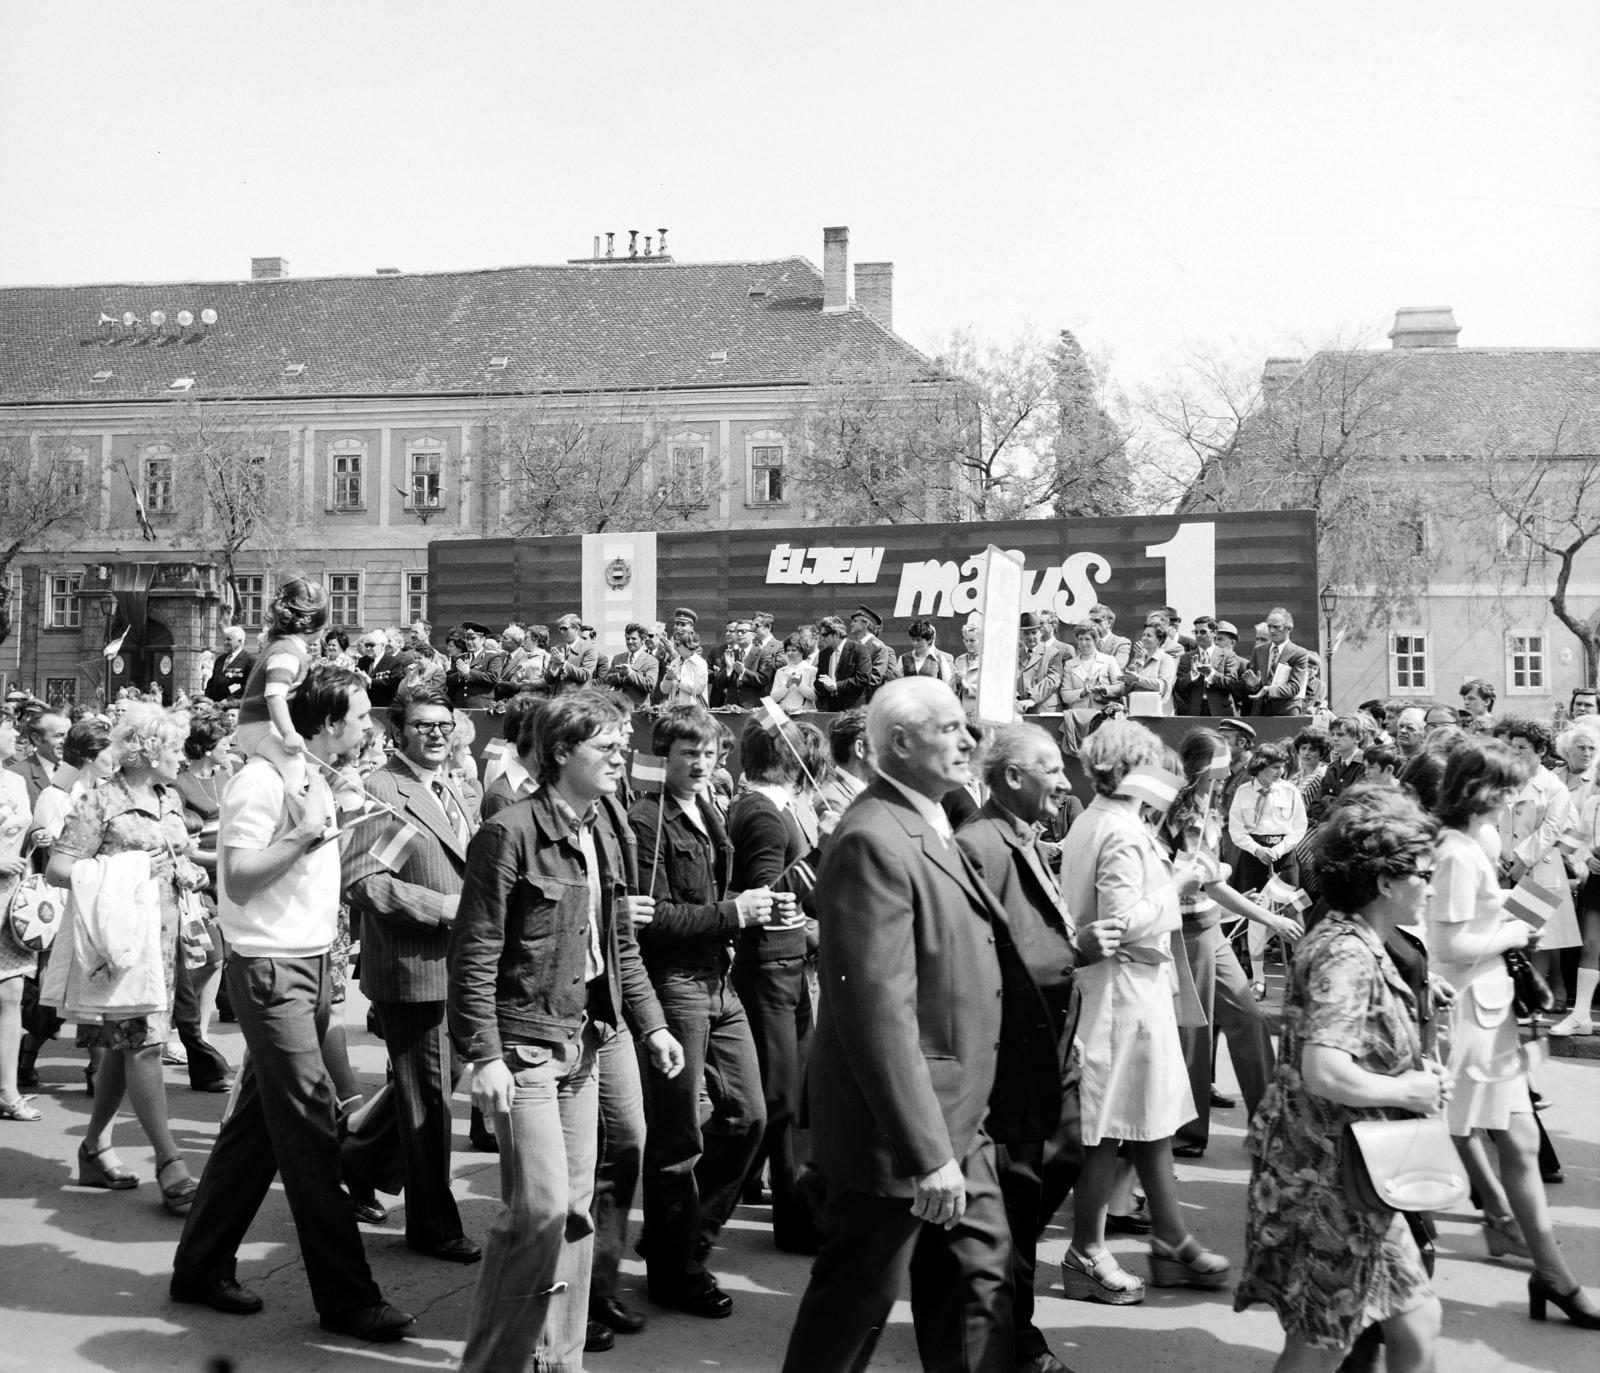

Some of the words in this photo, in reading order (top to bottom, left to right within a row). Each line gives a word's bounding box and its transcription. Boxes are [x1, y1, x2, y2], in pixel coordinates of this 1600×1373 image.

[766, 543, 885, 584] ÉLJEN
[893, 549, 1112, 625] máus
[1146, 522, 1216, 639] 1
